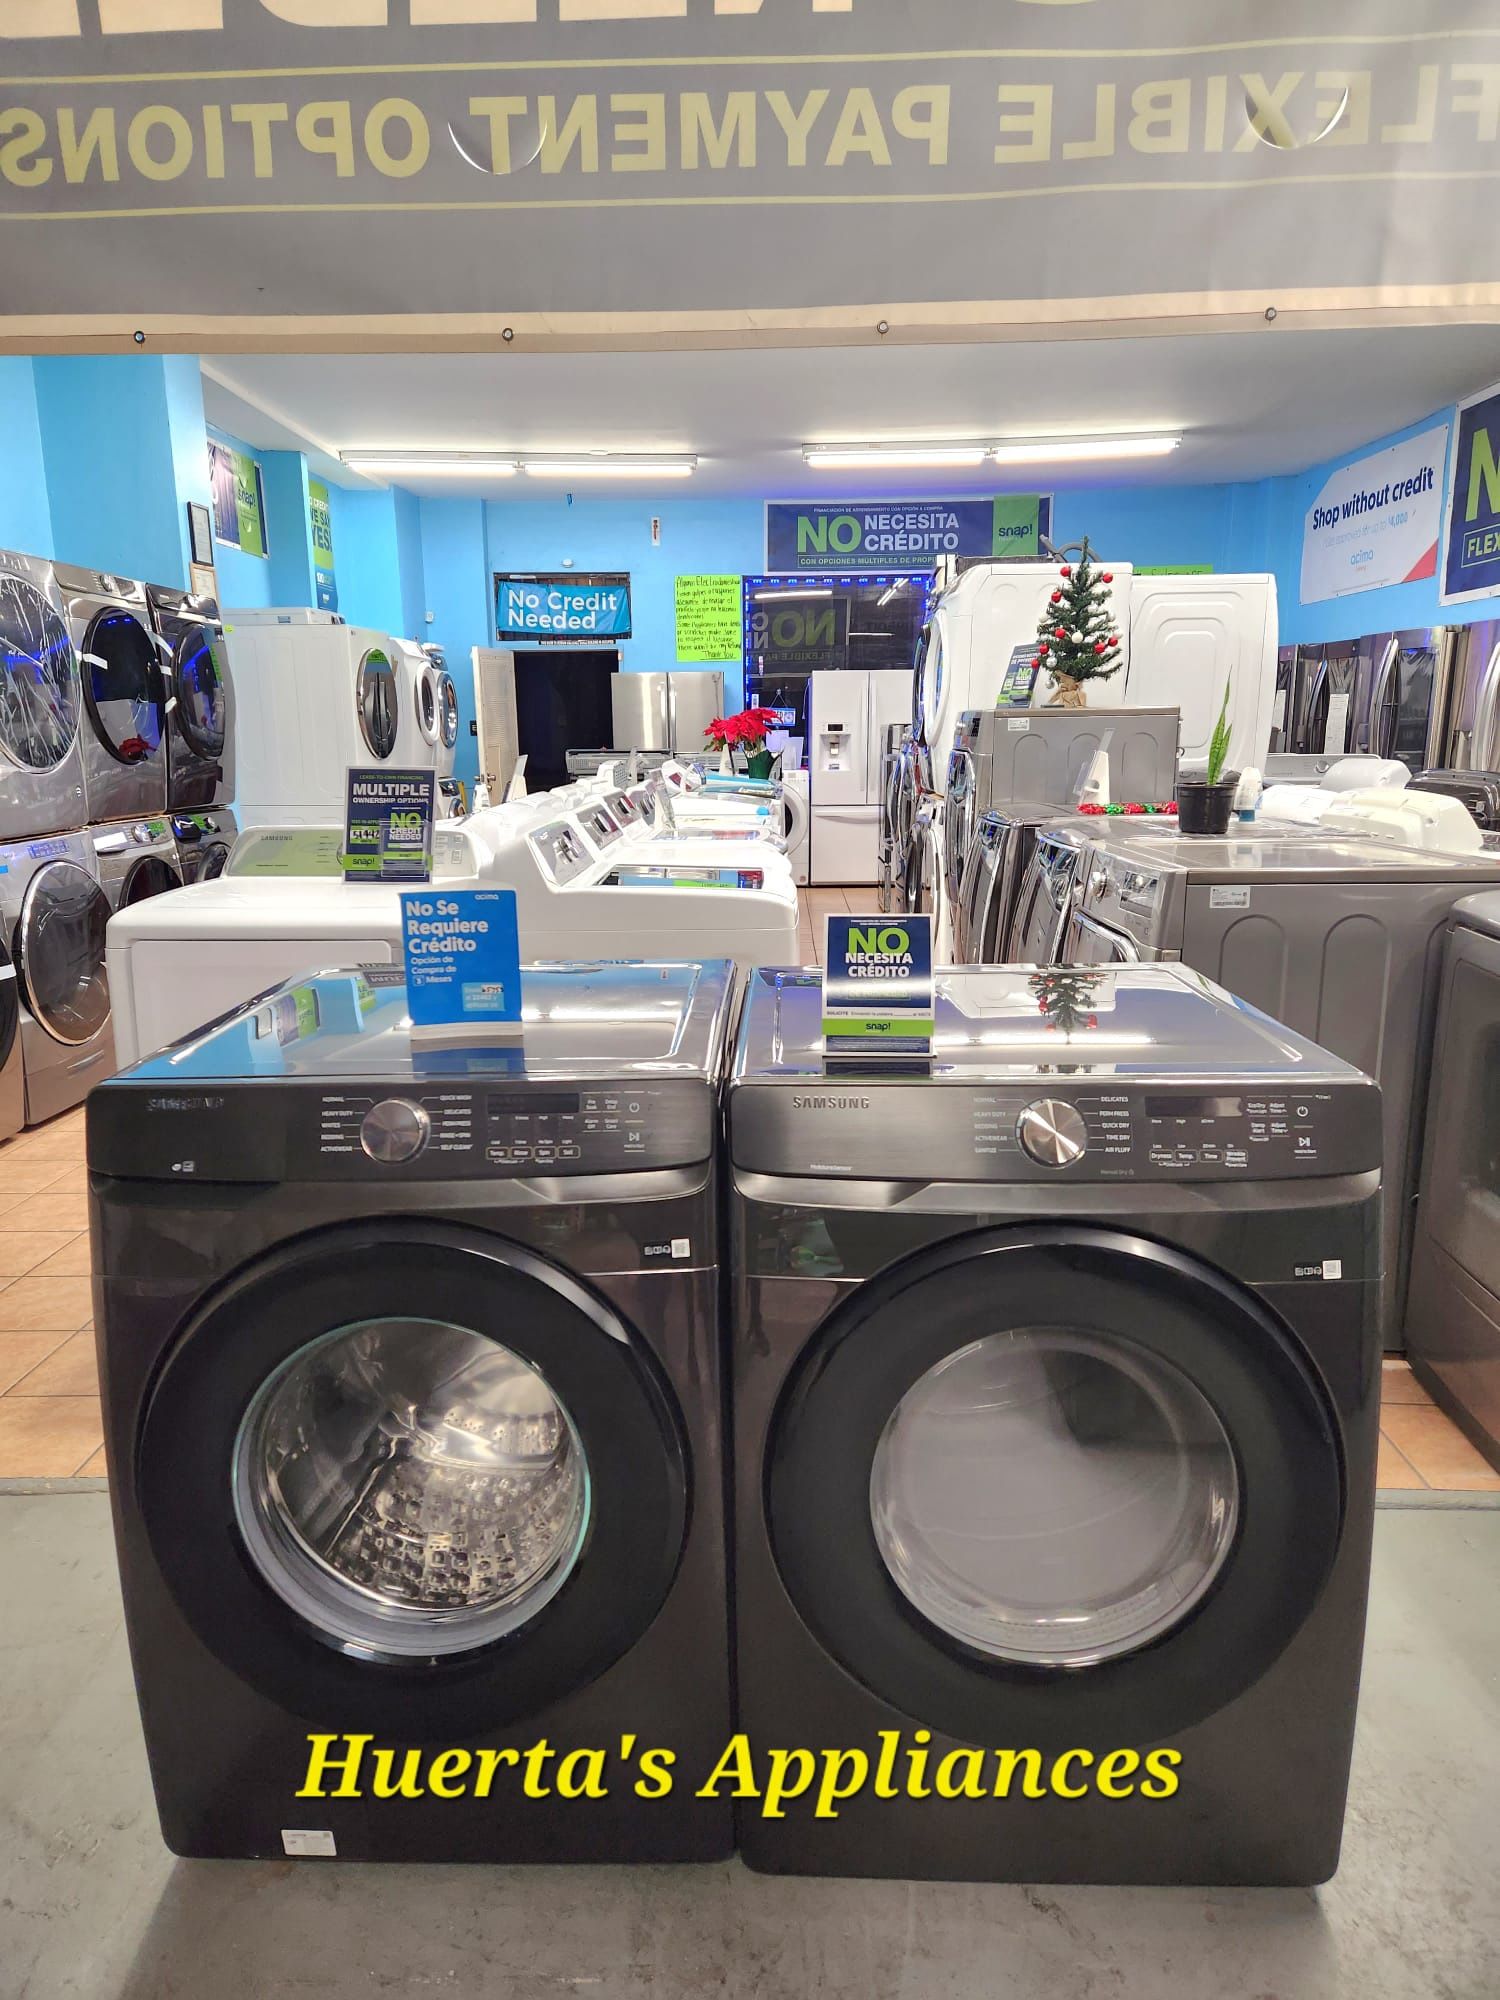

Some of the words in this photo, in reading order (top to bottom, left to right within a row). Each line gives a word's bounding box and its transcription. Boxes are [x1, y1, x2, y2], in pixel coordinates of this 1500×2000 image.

[1312, 507, 1339, 530] Shop
[1342, 484, 1390, 520] without
[1392, 466, 1434, 502] credit
[797, 515, 862, 553] NO
[864, 513, 960, 530] NECESITA
[998, 523, 1033, 539] snap!
[864, 530, 960, 551] CRÉDITO
[508, 589, 540, 609] No
[547, 591, 617, 611] Credit
[508, 608, 596, 630] Needed
[352, 783, 430, 796] MULTIPLE
[390, 812, 422, 829] NO
[352, 858, 375, 866] snap!
[406, 901, 433, 916] No
[436, 899, 459, 915] Se
[407, 917, 489, 938] Requiere
[408, 935, 477, 954] Crédito
[847, 927, 910, 955] NO
[442, 955, 455, 963] de
[845, 952, 913, 964] NECESITA
[445, 965, 457, 973] de
[848, 962, 910, 978] CRÉDITO
[866, 1022, 891, 1031] snap!
[792, 1095, 870, 1109] SAMSUNG
